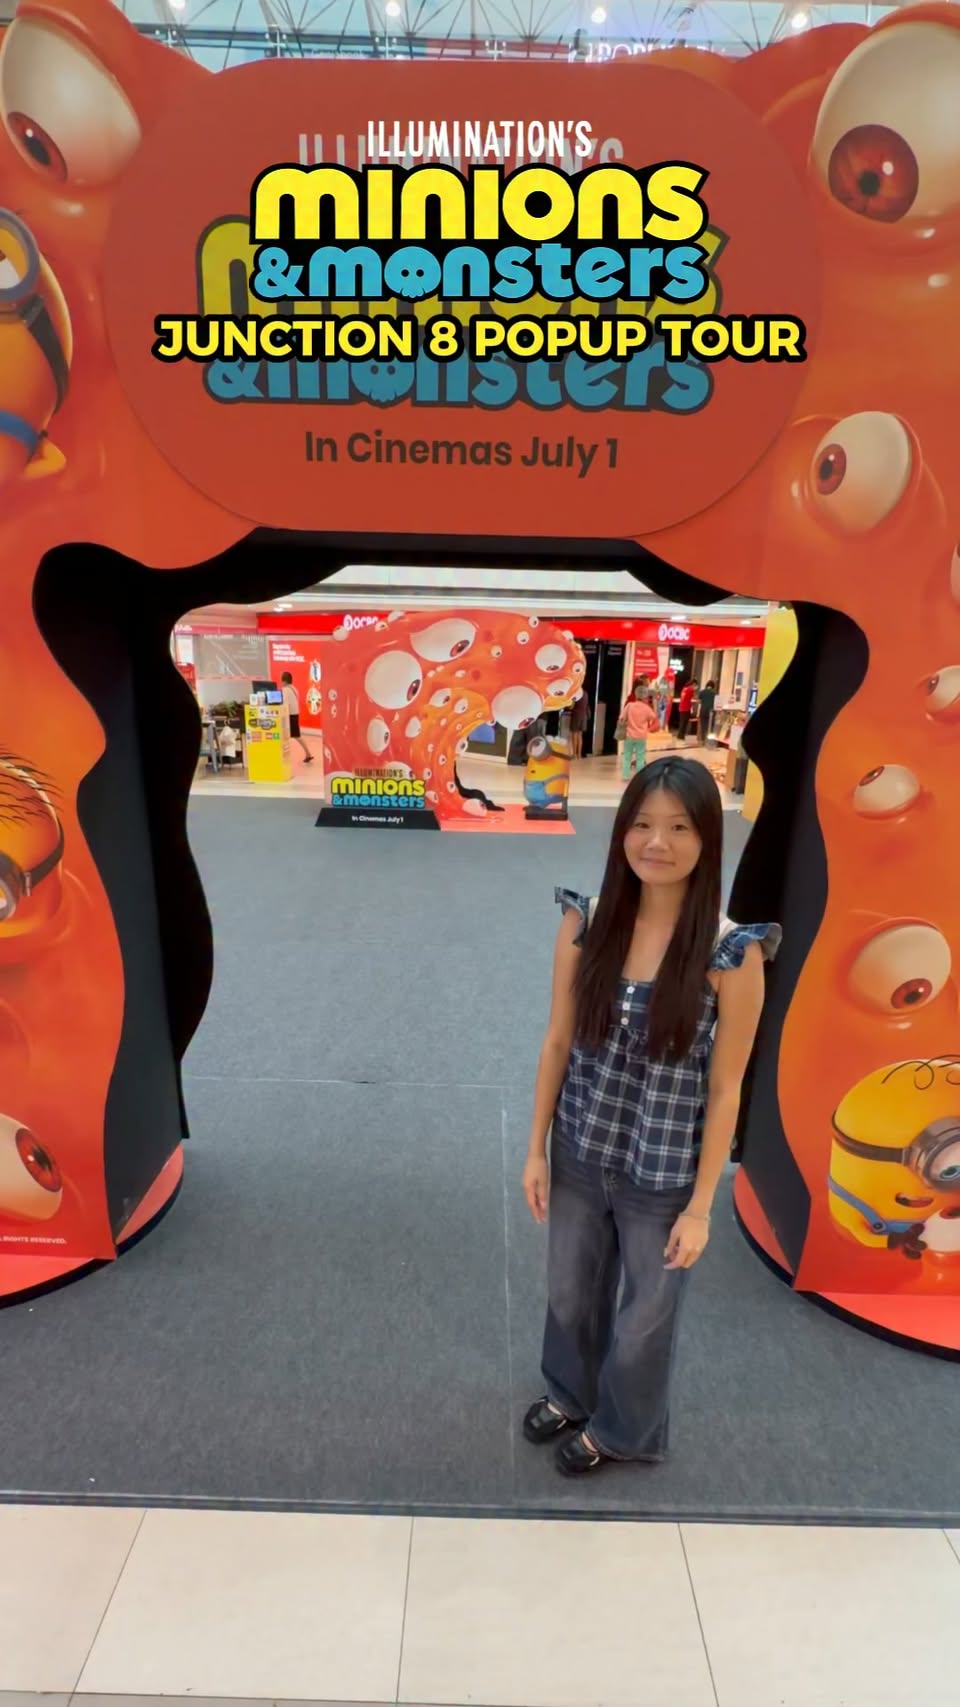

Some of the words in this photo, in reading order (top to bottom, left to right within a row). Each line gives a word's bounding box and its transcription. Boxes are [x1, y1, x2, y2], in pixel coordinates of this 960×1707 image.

[304, 431, 338, 462] In
[347, 429, 513, 466] Cinemas
[520, 436, 600, 479] July
[606, 438, 619, 468] 1
[667, 627, 690, 640] OCBC
[360, 815, 386, 823] Cinemas
